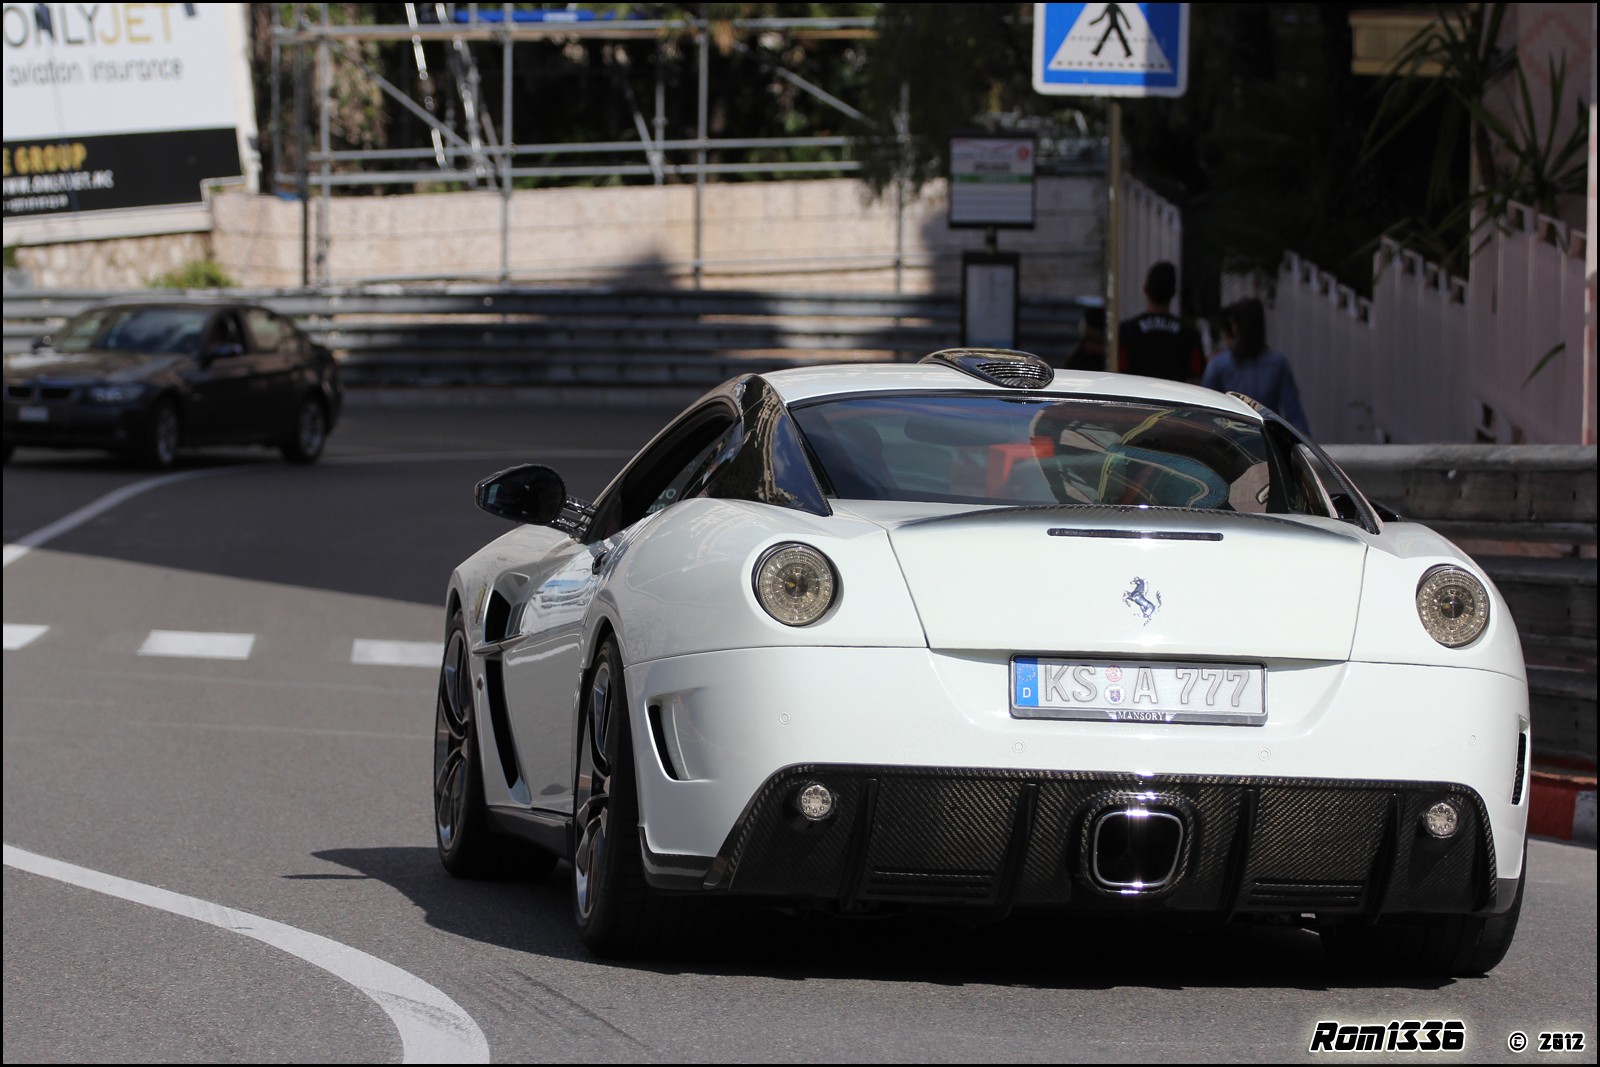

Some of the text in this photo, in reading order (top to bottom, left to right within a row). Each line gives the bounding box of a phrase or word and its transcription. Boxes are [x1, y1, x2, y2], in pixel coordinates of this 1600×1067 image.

[4, 3, 176, 47] ONLYJET
[9, 57, 183, 86] aviation insurance
[14, 142, 87, 175] GROUP
[1022, 687, 1032, 699] D
[1044, 664, 1250, 708] KS A 777
[1116, 710, 1167, 722] MANSORY
